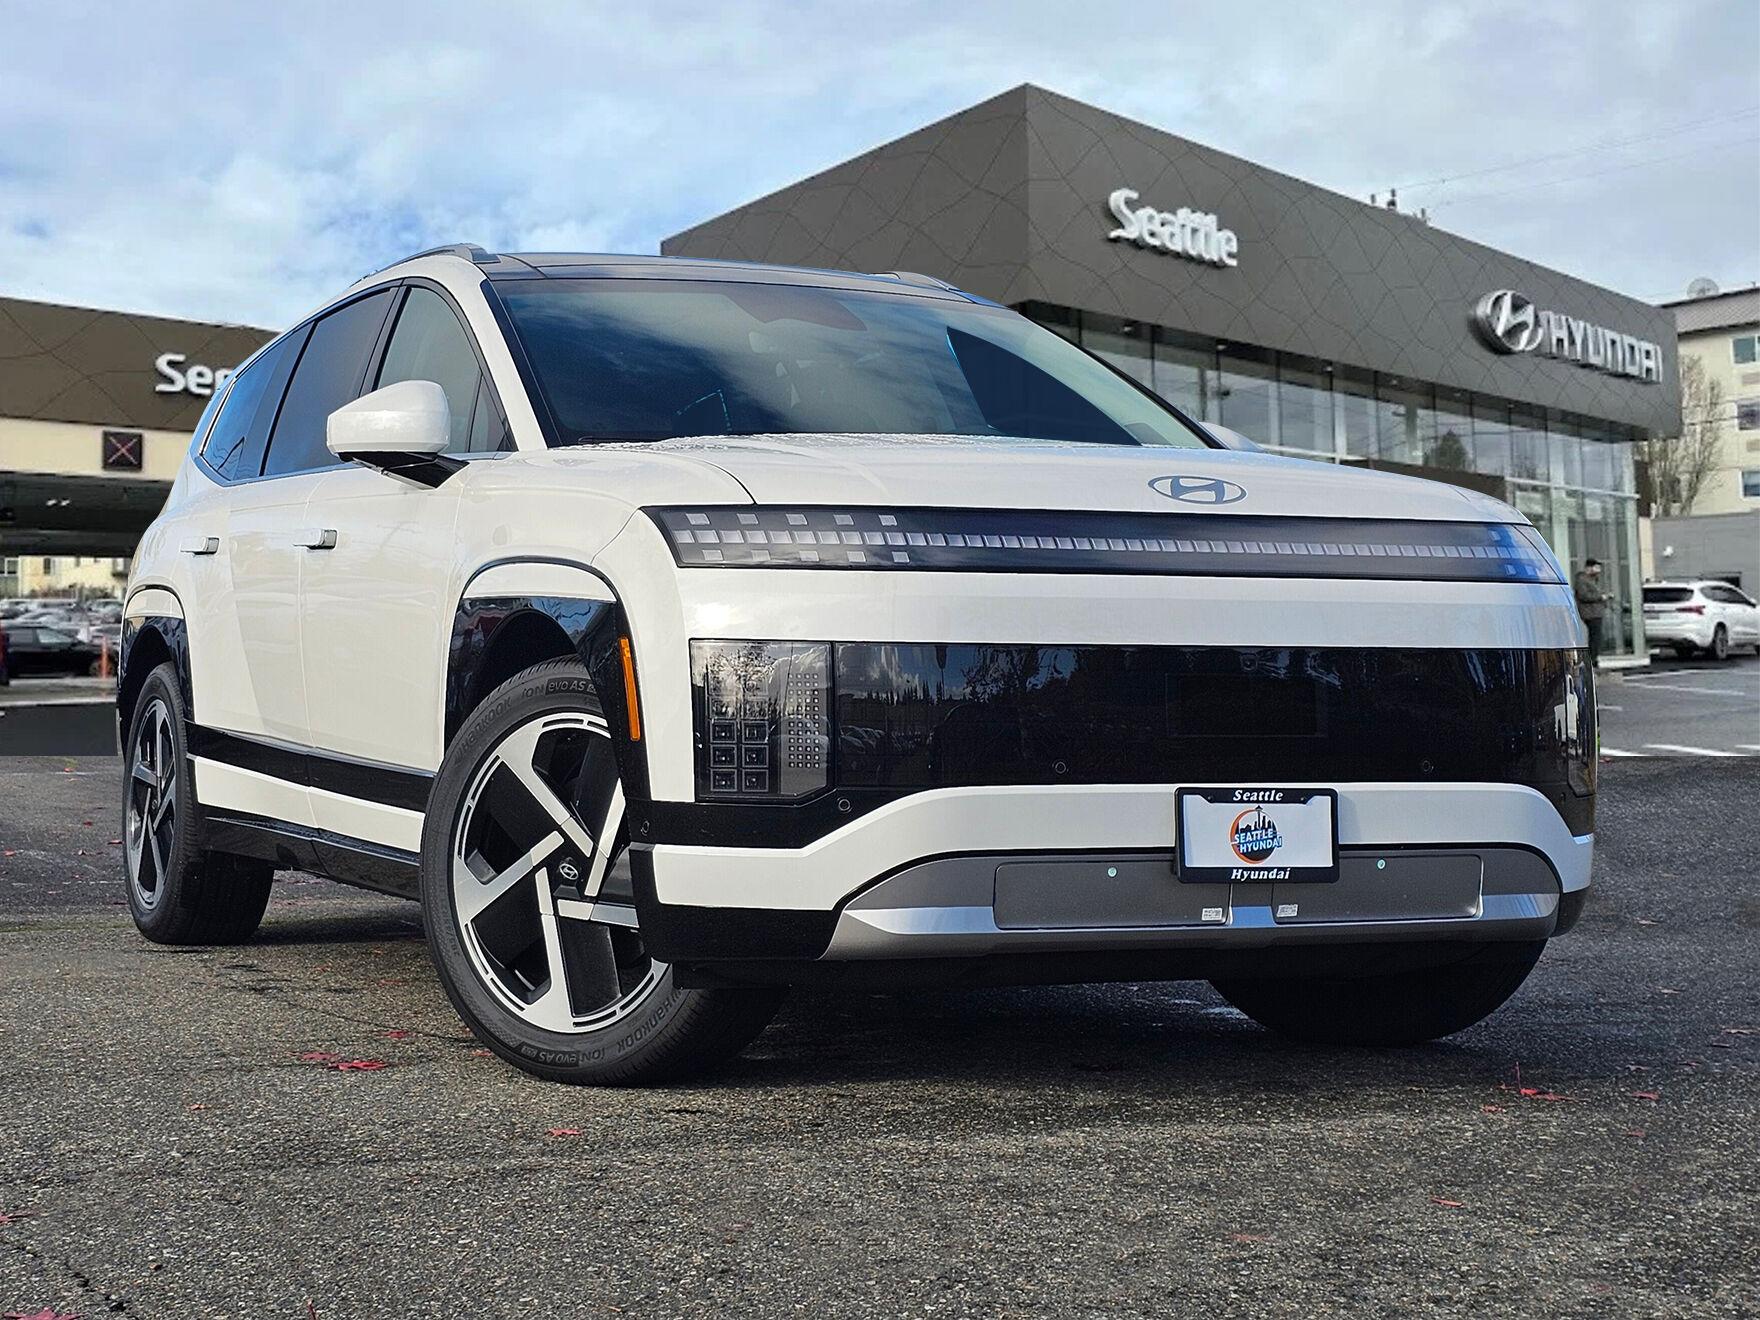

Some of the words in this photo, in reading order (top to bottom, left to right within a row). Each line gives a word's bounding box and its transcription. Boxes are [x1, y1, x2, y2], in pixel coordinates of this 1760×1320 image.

[1108, 188, 1238, 266] Seattle
[1540, 311, 1663, 383] HYUNDAI
[1233, 789, 1284, 801] Seattle
[1234, 829, 1275, 845] SEATTLE
[1239, 836, 1282, 853] HYUNDAI
[1231, 868, 1291, 881] Hyundai
